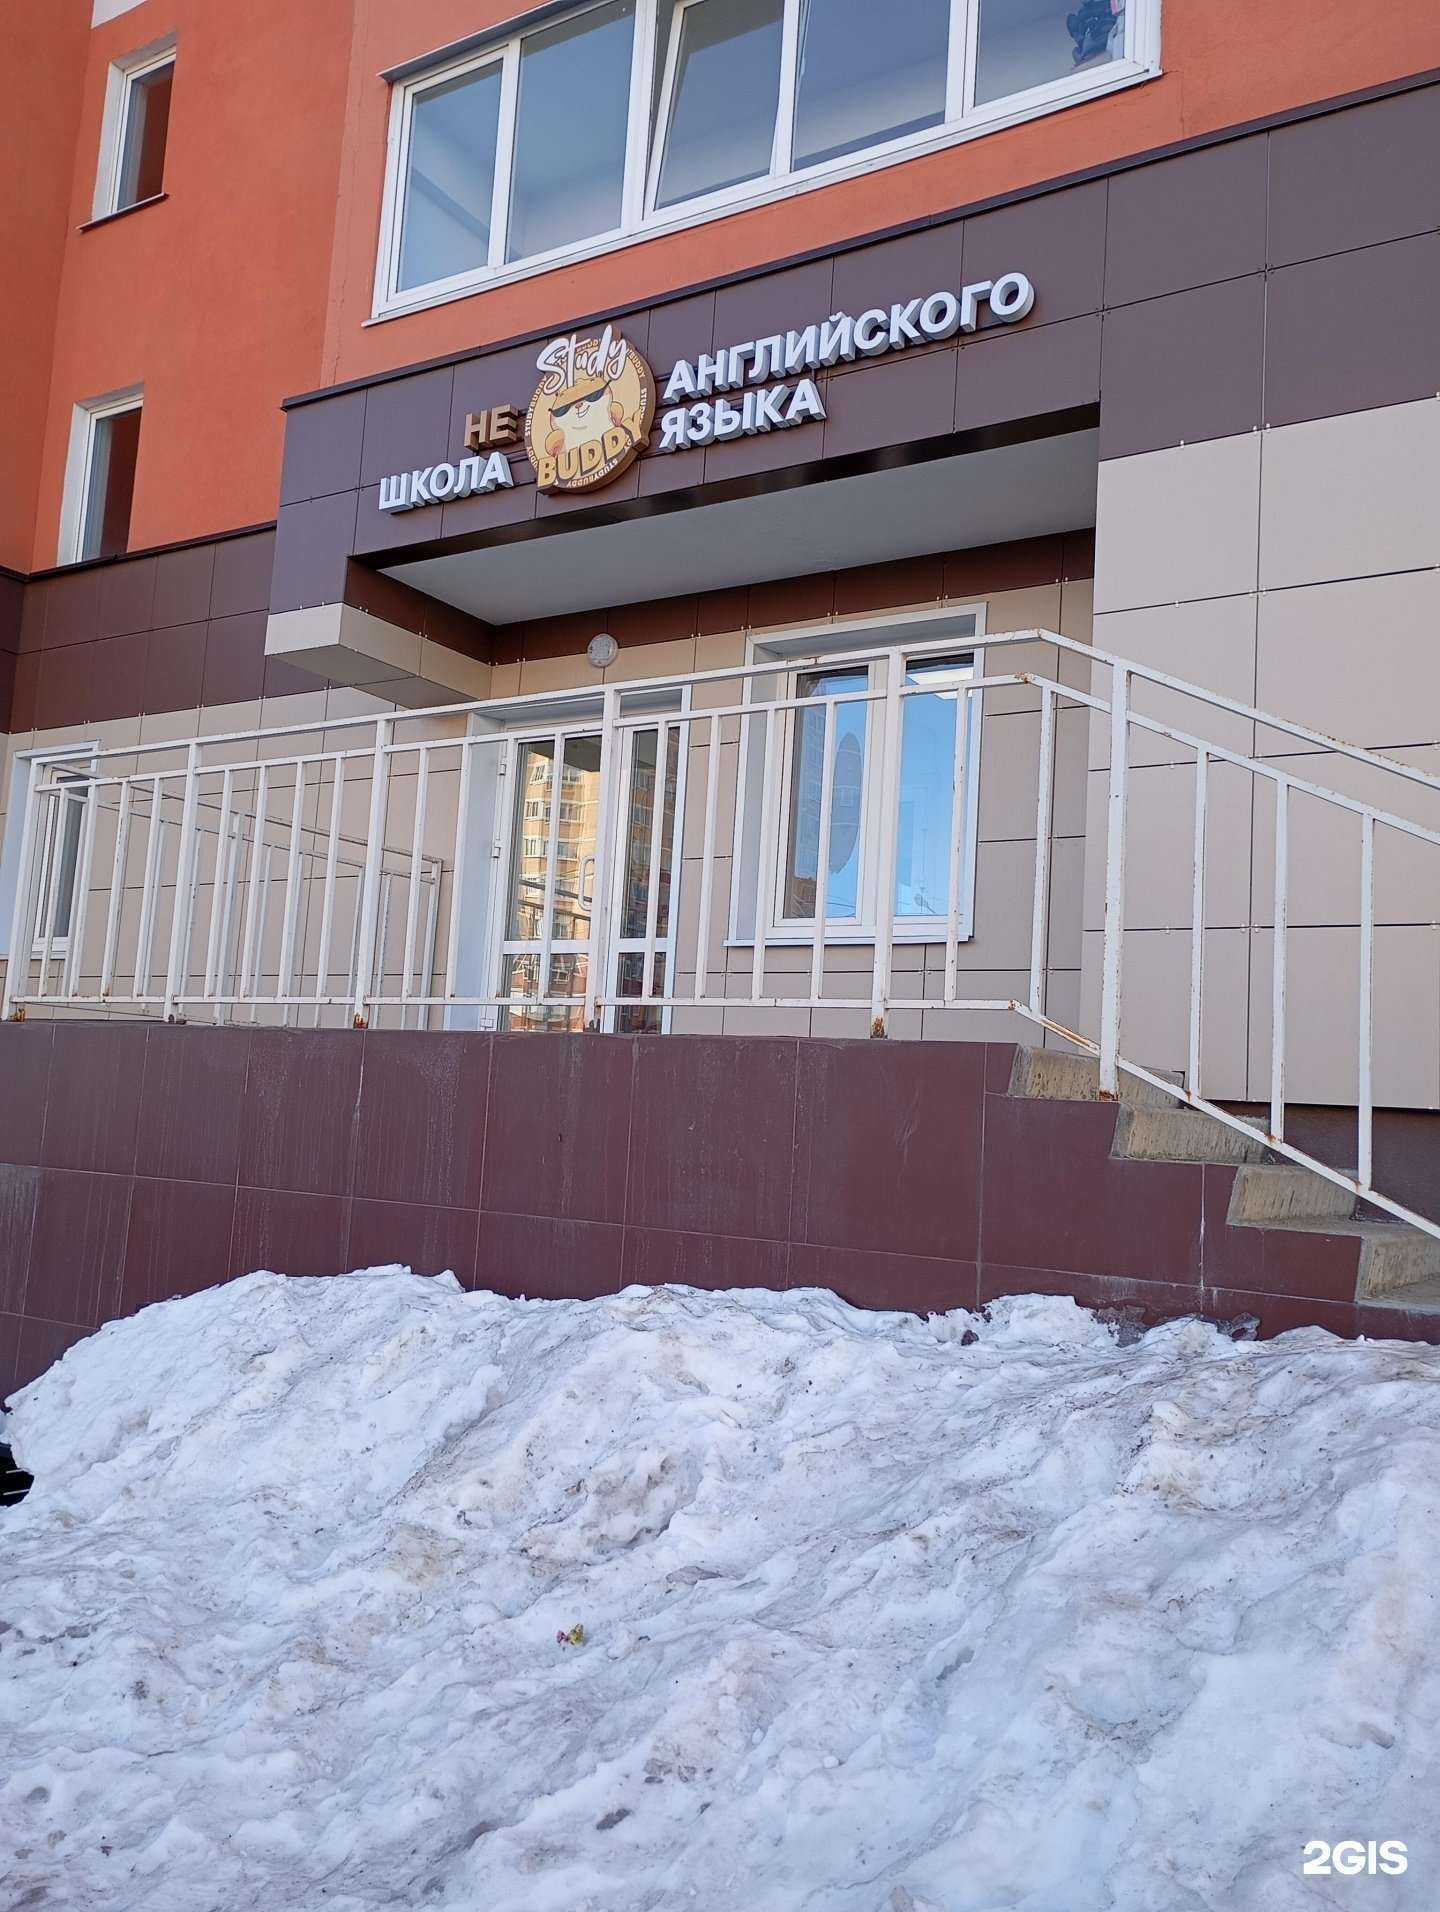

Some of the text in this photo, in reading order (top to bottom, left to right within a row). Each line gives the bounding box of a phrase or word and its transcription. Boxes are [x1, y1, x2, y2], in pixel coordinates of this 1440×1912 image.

[536, 325, 627, 398] Study
[663, 272, 1034, 402] АНГЛИЙСКОГО
[464, 404, 518, 450] НЕ
[537, 409, 642, 488] BUDDY
[659, 378, 828, 453] ЯЗЫКА
[379, 451, 514, 514] ШКОЛА
